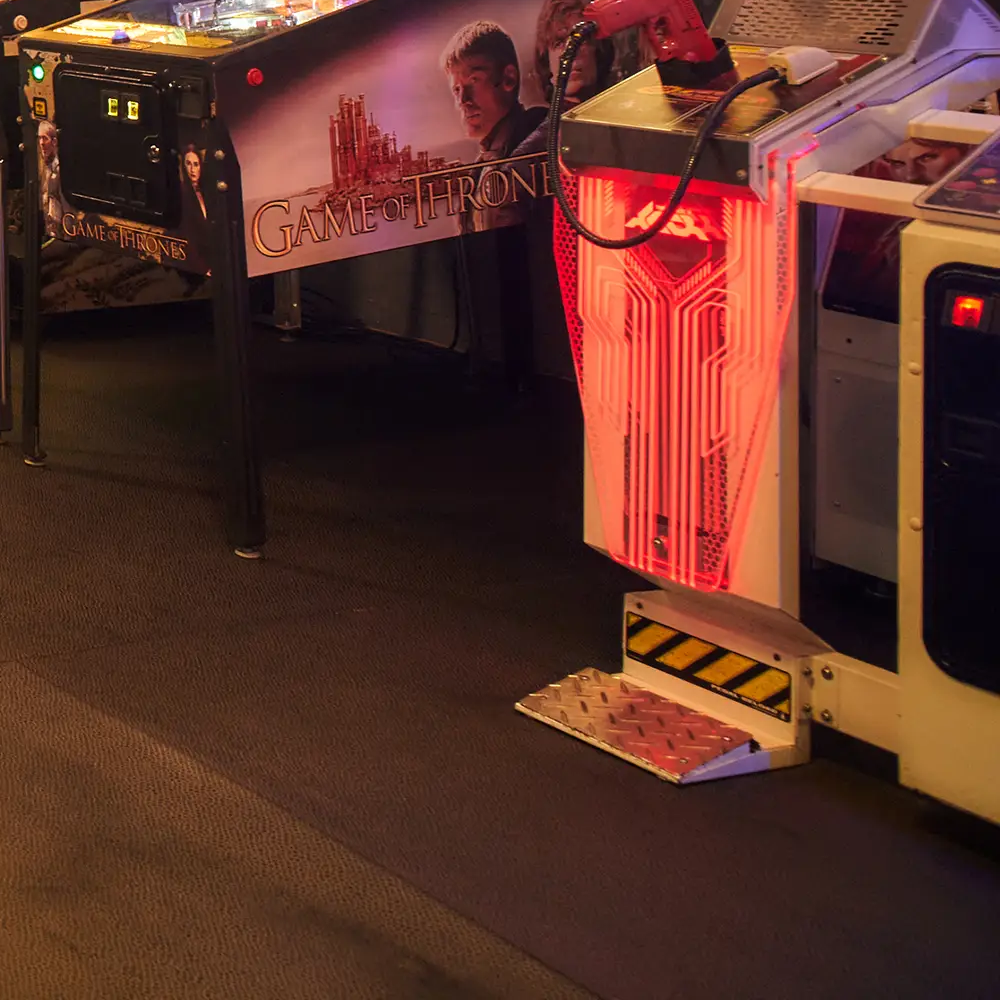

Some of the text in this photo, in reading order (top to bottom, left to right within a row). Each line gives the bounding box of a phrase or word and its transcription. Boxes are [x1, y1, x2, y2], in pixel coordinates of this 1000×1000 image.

[62, 213, 106, 241] GAME
[114, 223, 188, 260] THRONES
[251, 194, 377, 257] GAME
[382, 194, 410, 222] OF
[403, 152, 554, 229] THRONE
